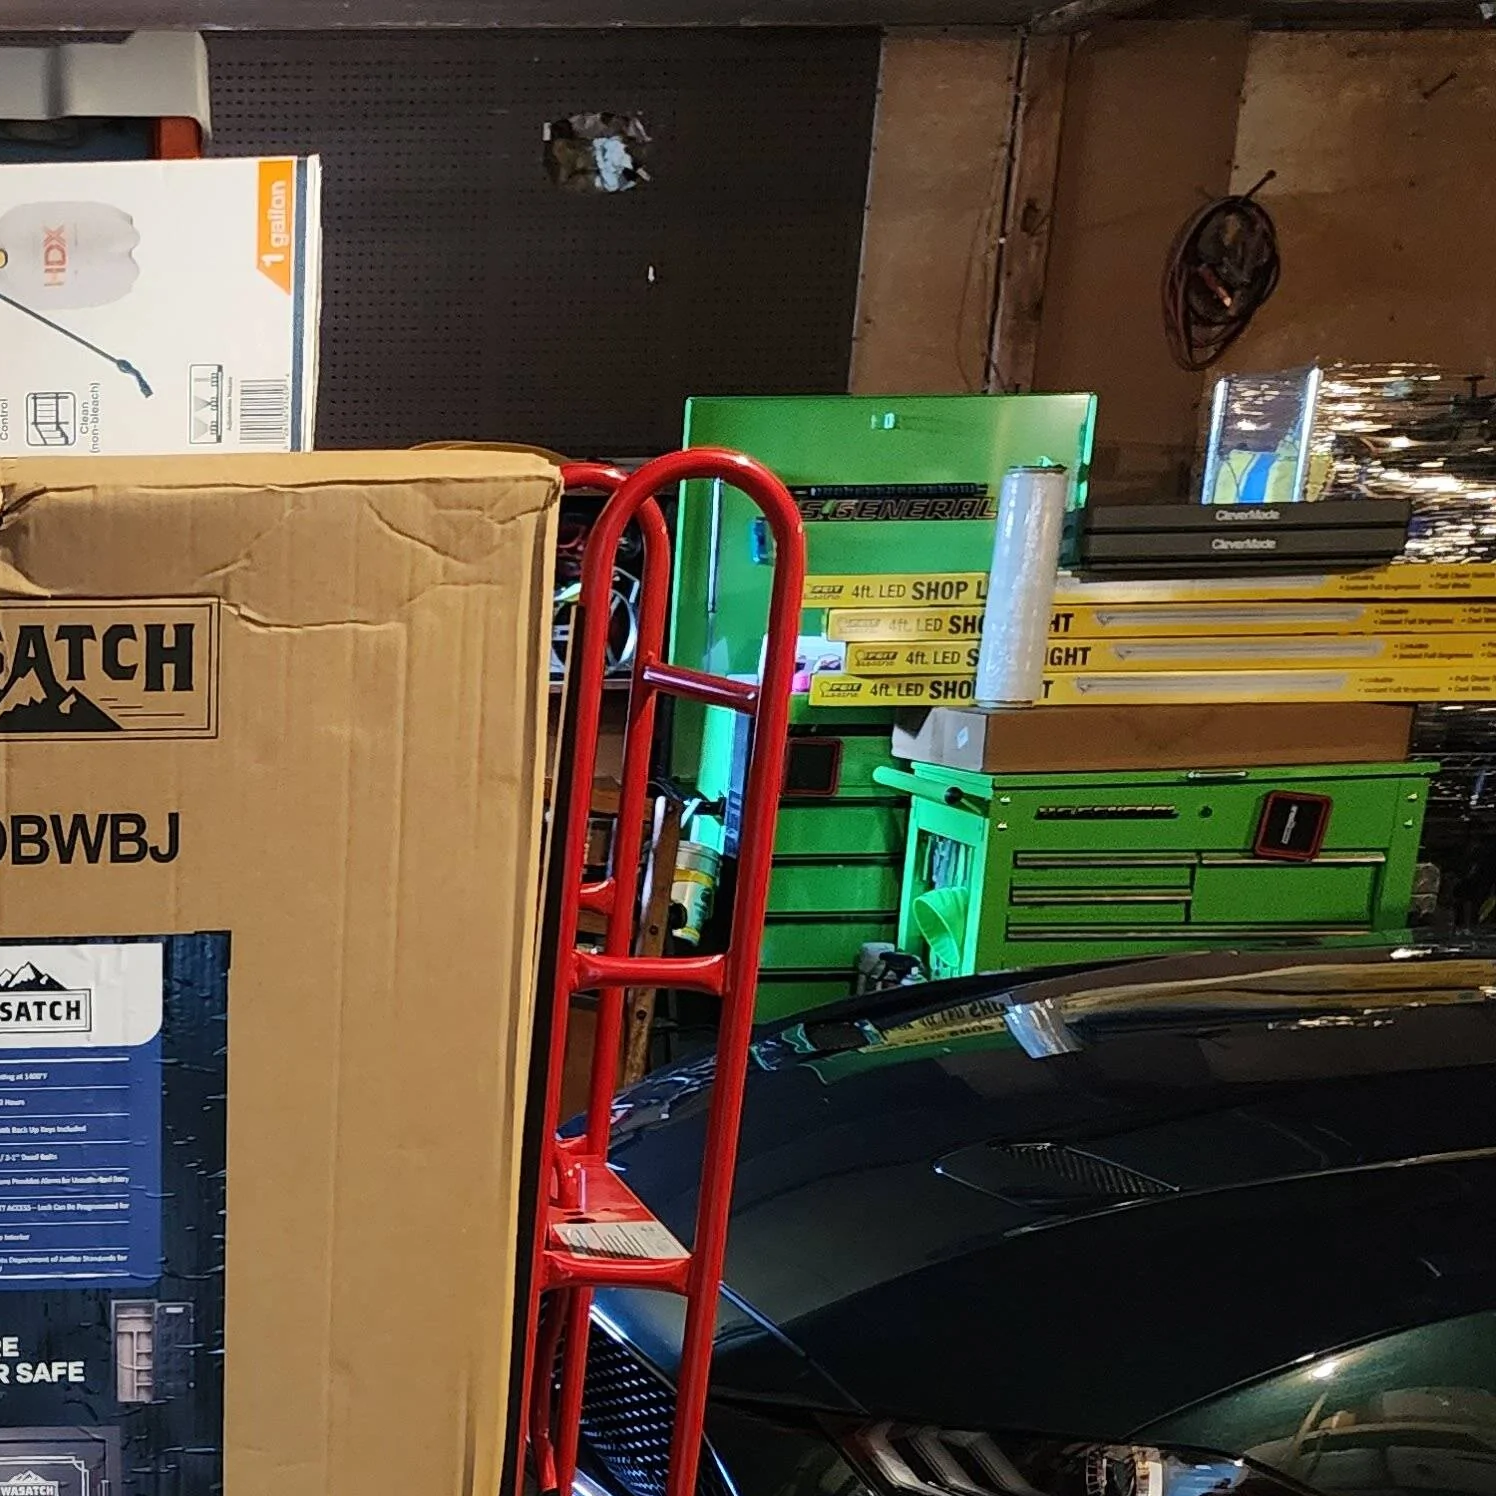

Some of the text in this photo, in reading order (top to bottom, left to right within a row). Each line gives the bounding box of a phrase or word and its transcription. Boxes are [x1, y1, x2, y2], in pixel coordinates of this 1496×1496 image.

[261, 180, 290, 268] 1 gallon
[43, 225, 66, 286] HDX
[0, 398, 9, 441] Control
[80, 401, 89, 435] Clean
[90, 382, 101, 453] (non-bleach)
[800, 499, 998, 520] S.GENERAL
[880, 584, 906, 598] LED
[912, 582, 968, 600] SHOP
[916, 618, 942, 632] LED
[948, 614, 984, 634] SH
[933, 650, 960, 664] LED
[1044, 647, 1091, 666] IGHT
[897, 682, 924, 696] LED
[929, 680, 976, 699] SHO
[15, 1360, 85, 1383] SAFE
[0, 1485, 54, 1496] WASATCH
